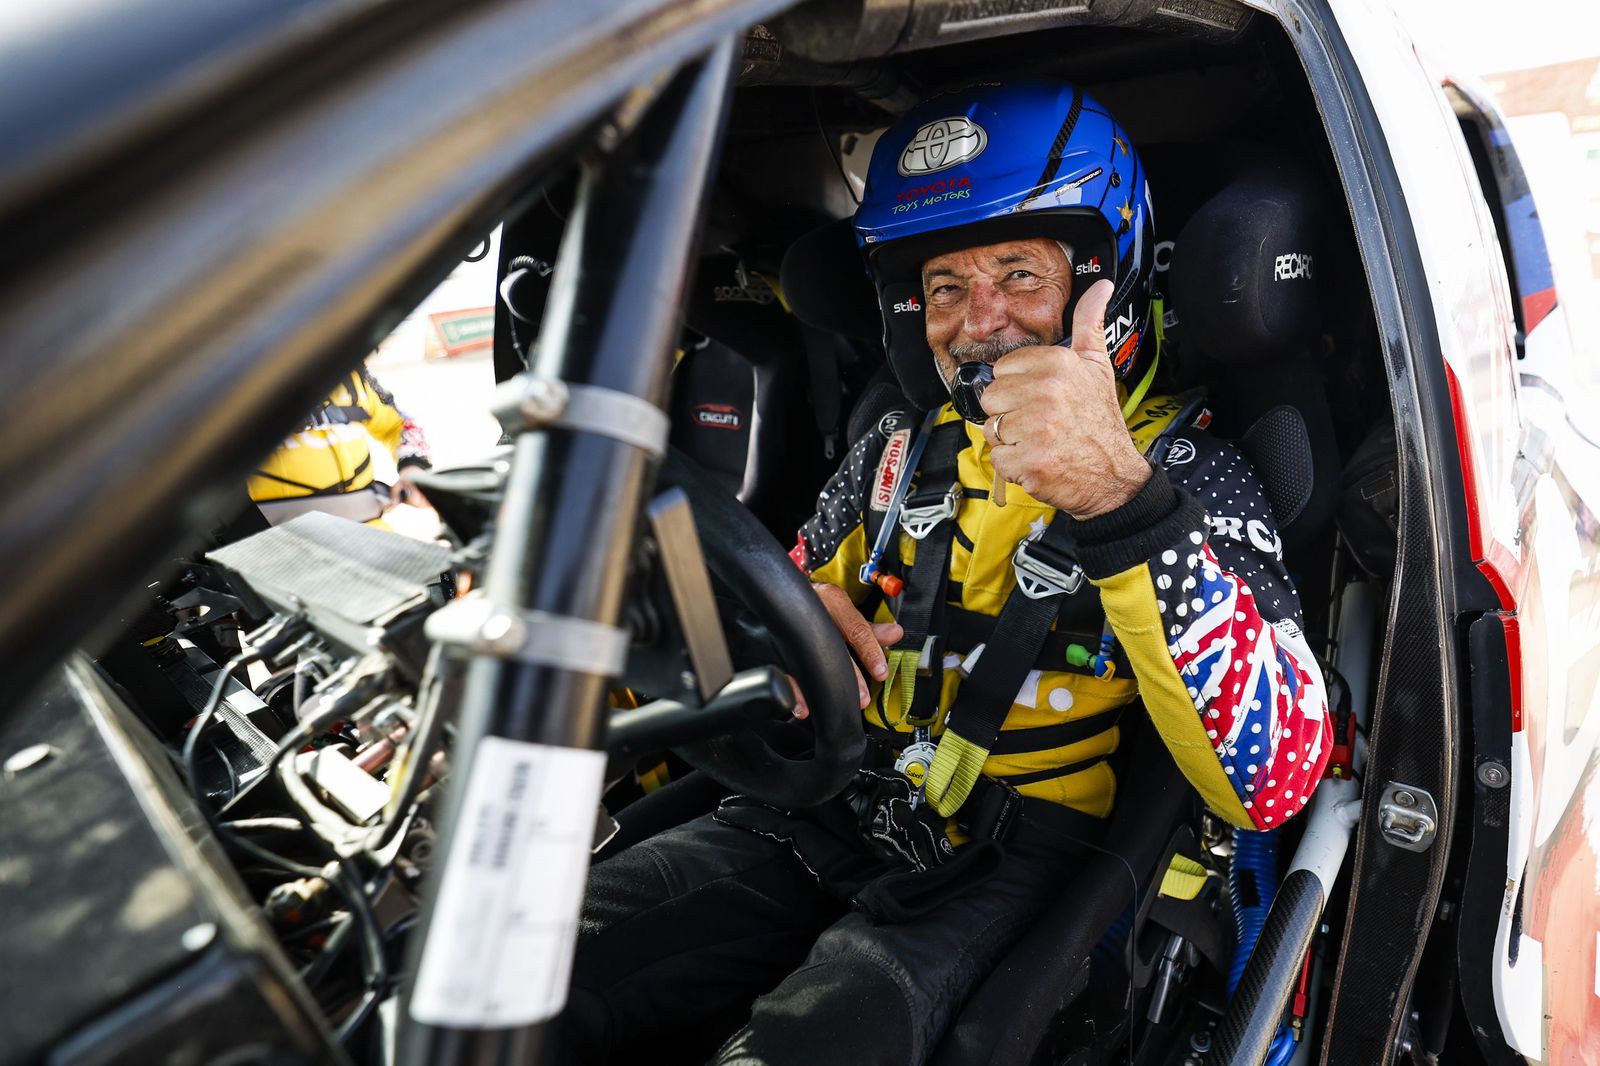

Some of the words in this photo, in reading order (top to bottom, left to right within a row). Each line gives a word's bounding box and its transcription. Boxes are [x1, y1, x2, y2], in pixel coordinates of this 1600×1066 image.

[891, 200, 919, 214] TOYS
[922, 189, 972, 207] MOTORS
[897, 177, 972, 203] TOYOTA
[879, 439, 902, 502] SIMPSON
